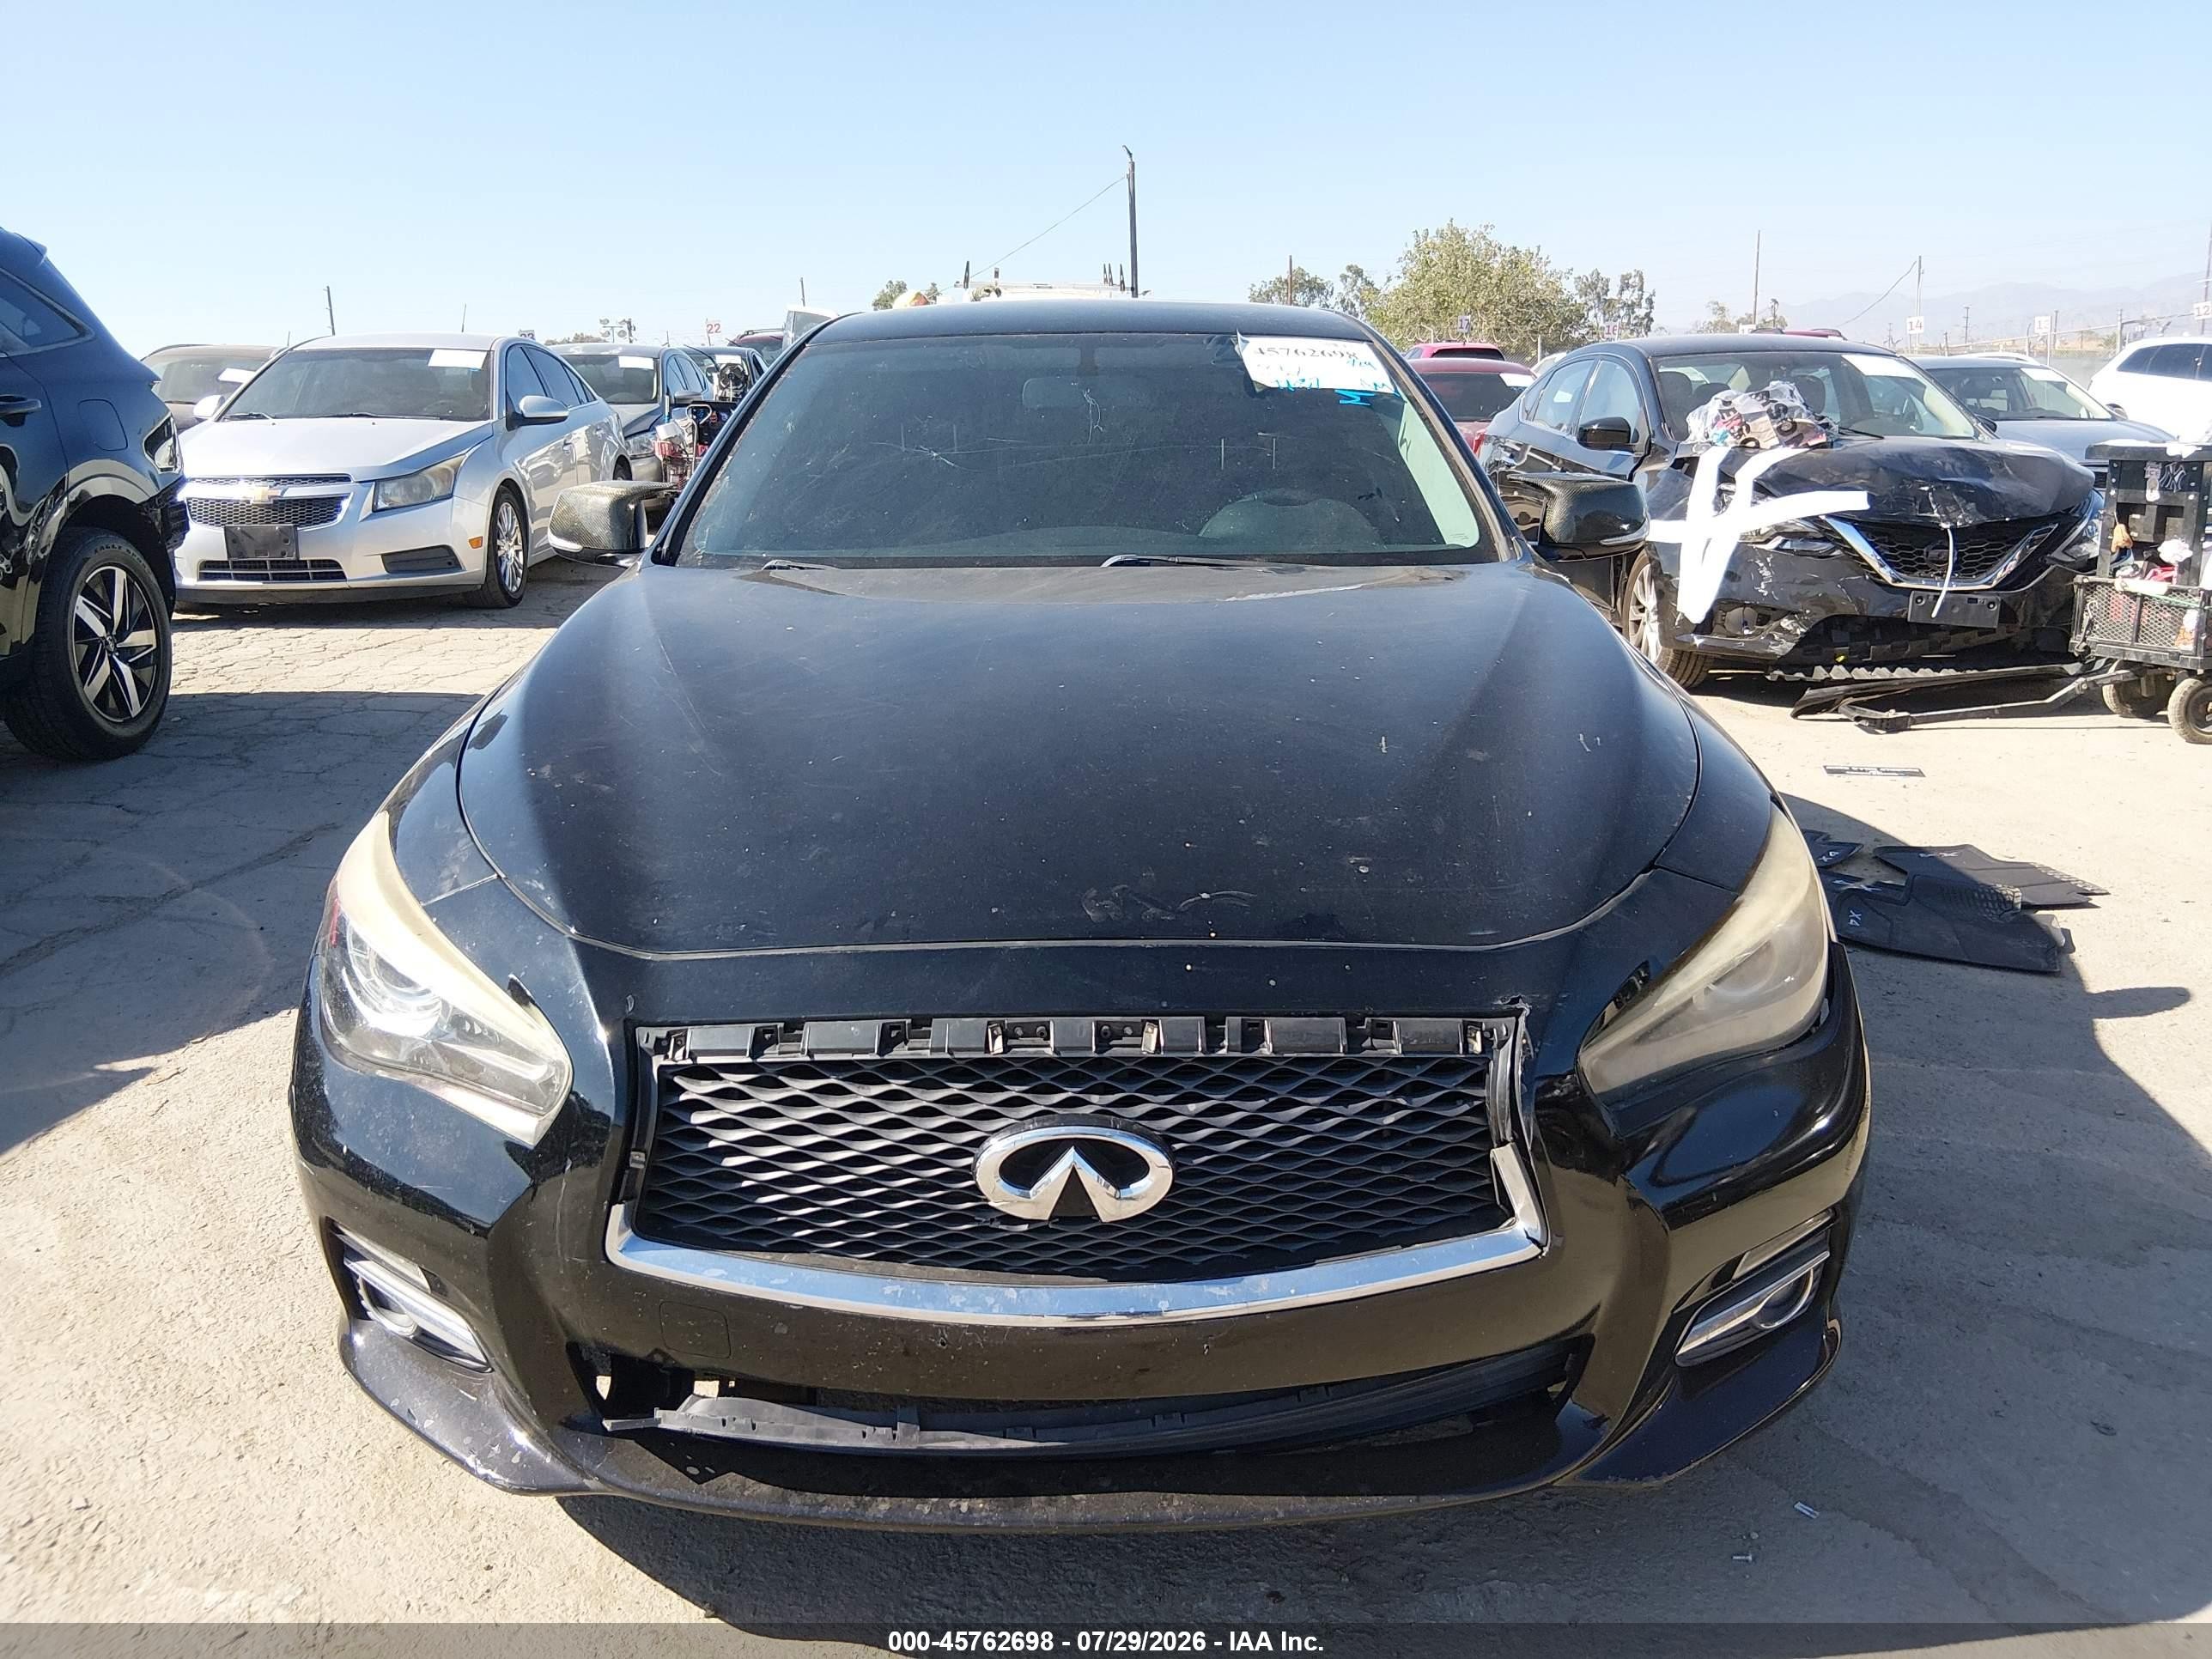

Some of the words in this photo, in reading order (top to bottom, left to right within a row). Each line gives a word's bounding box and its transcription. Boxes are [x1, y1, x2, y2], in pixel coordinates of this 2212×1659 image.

[707, 323, 721, 334] 22
[1459, 319, 1470, 330] 17
[1908, 319, 1923, 331] 14
[1848, 909, 1862, 927] X4
